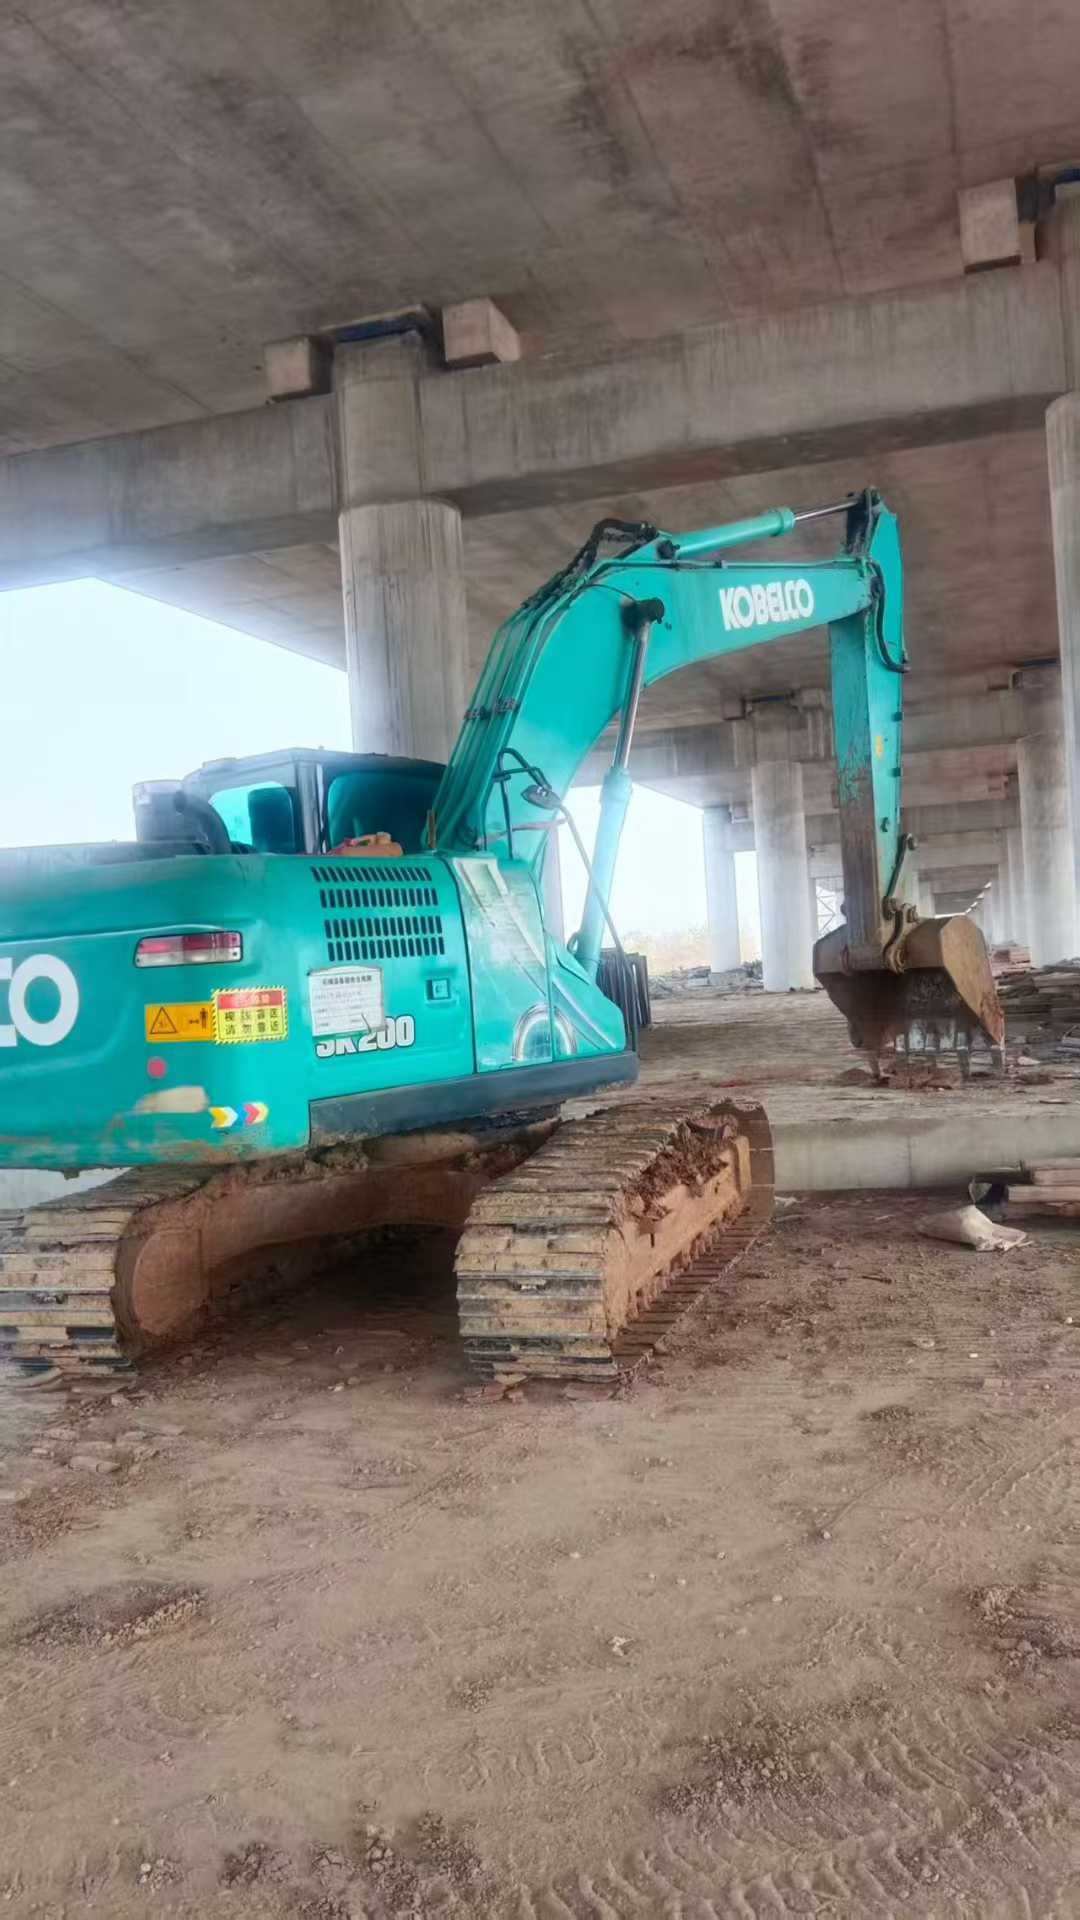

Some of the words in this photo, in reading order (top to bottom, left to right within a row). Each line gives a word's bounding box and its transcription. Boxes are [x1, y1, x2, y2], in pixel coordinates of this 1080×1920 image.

[719, 579, 814, 630] KOBELCO
[225, 1021, 279, 1035] 请勿靠近
